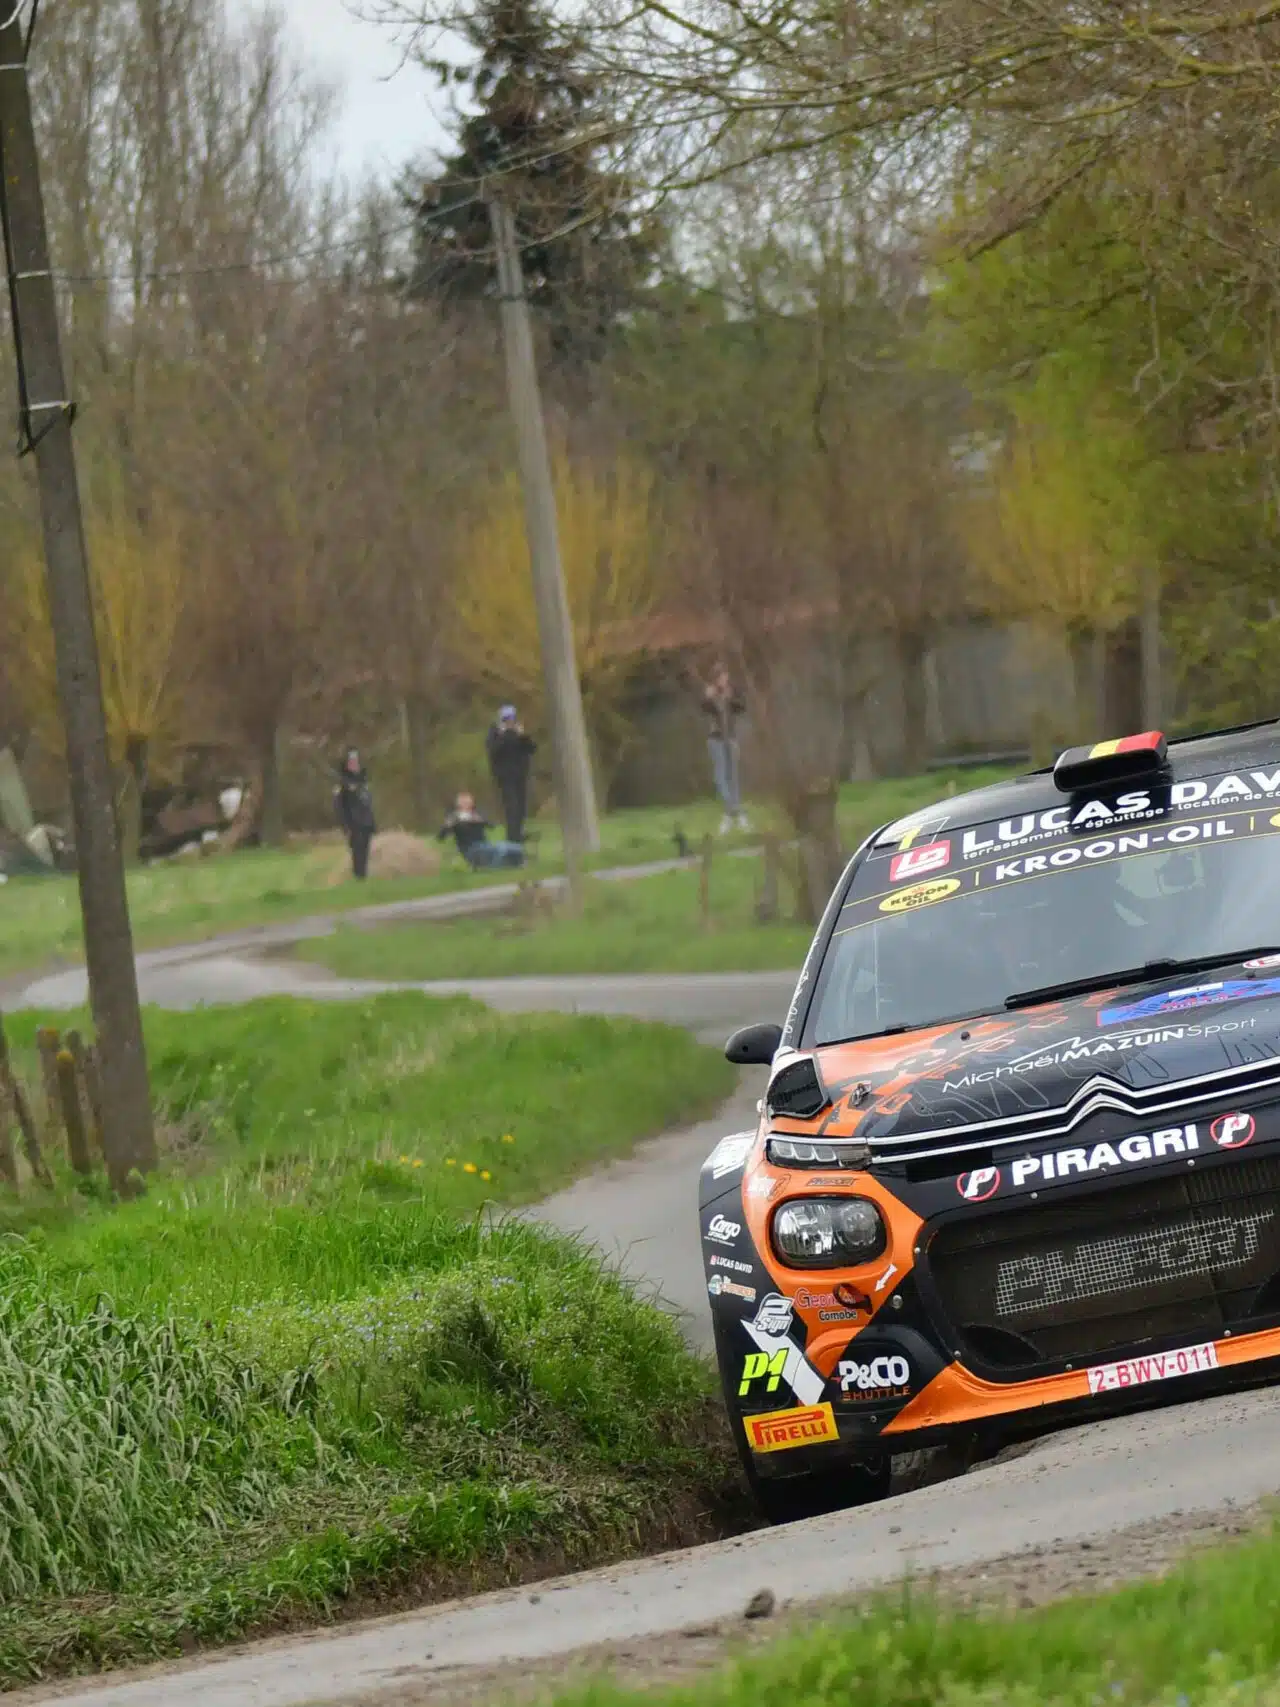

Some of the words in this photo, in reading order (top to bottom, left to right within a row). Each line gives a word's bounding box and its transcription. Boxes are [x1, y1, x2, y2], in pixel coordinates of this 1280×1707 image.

[963, 791, 1151, 853] LUCAS
[963, 827, 1070, 860] terrassement
[1085, 807, 1164, 829] égouttage
[1178, 793, 1240, 811] location
[1243, 791, 1263, 801] de
[995, 820, 1235, 881] KROON-OIL
[890, 884, 949, 907] KROON
[906, 895, 931, 907] OIL
[1011, 1123, 1200, 1187] PIRAGRI
[709, 1214, 742, 1241] Cargo
[716, 1256, 736, 1270] LUCAS
[734, 1260, 753, 1274] DAVID
[755, 1316, 790, 1336] Sign
[818, 1310, 857, 1323] Comobe
[738, 1347, 790, 1397] P1
[839, 1355, 911, 1392] P&CO
[1093, 1345, 1214, 1393] 2-BWV-011
[841, 1385, 912, 1401] SHUTTLE
[752, 1409, 829, 1446] PIRELLI
